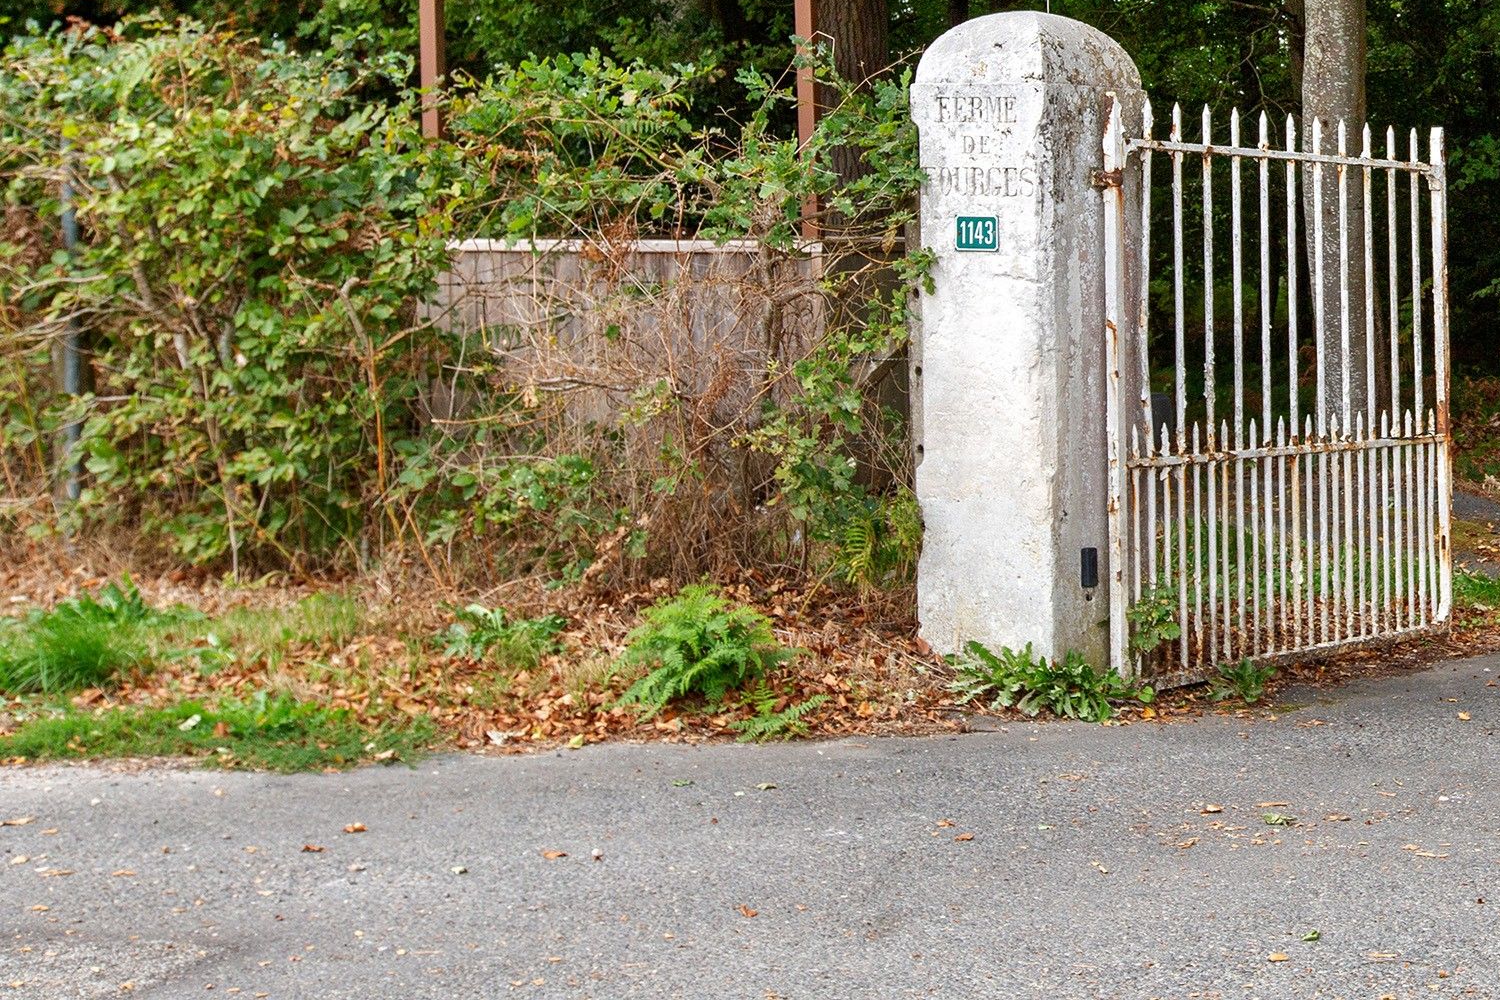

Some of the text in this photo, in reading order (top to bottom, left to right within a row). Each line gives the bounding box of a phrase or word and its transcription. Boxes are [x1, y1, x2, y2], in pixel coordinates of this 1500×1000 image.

[934, 96, 1018, 124] FERME
[962, 135, 992, 154] DE
[921, 166, 1035, 197] FOURGES
[959, 220, 994, 245] 1143
